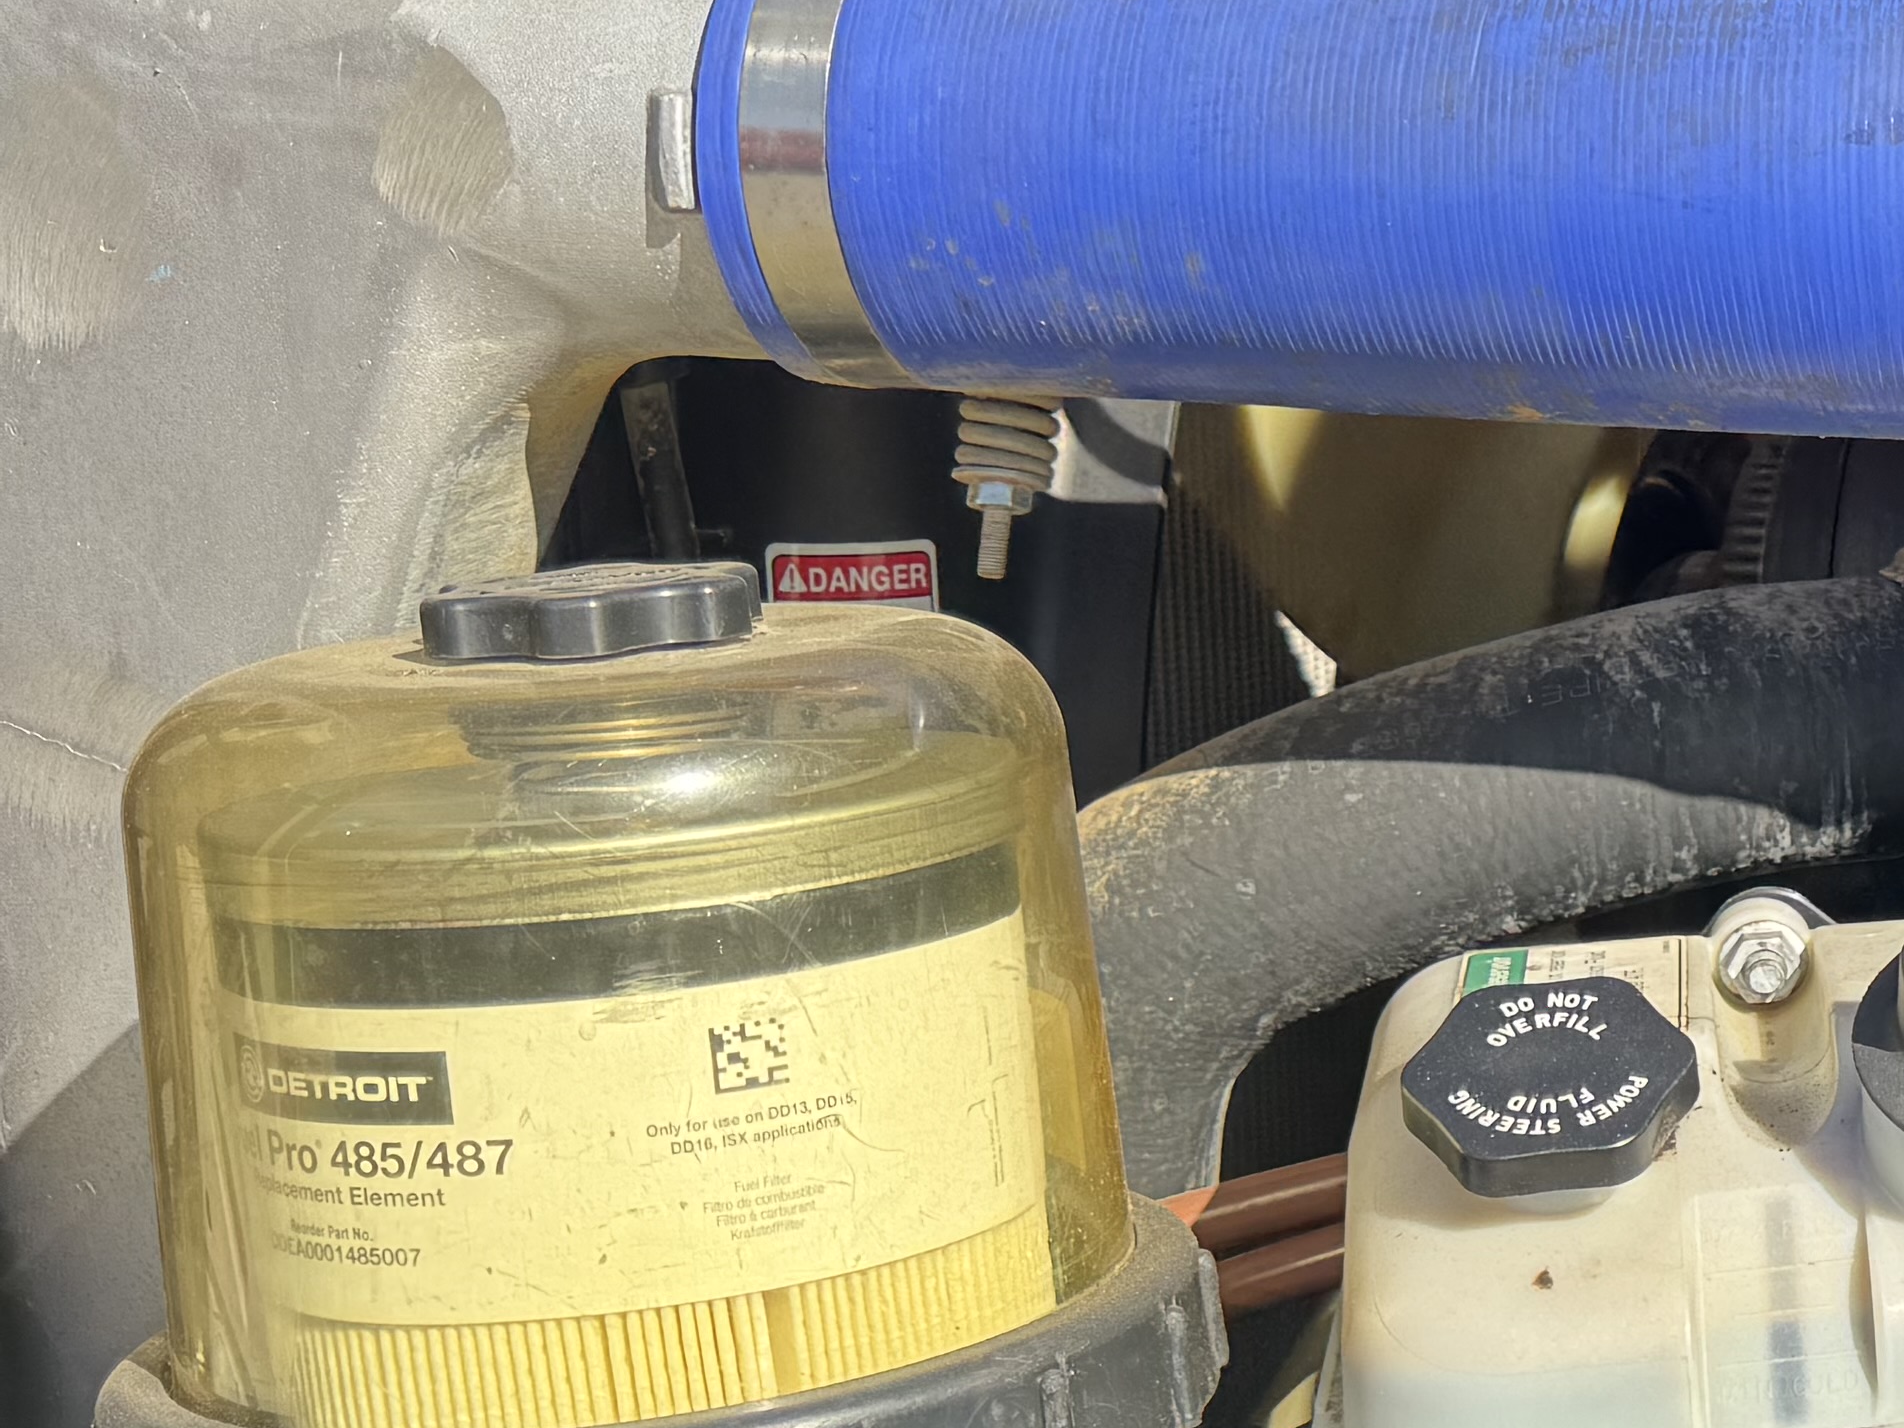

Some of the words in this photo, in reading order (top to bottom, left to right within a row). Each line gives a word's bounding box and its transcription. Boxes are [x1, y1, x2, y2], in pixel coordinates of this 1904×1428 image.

[808, 563, 927, 593] DANGER
[1499, 997, 1535, 1018] DO
[1547, 991, 1599, 1012] NOT
[1486, 1012, 1609, 1048] OVERFILL
[267, 1068, 428, 1102] DETROIT
[646, 1121, 681, 1138] Only
[686, 1119, 709, 1133] for
[745, 1112, 764, 1124] on
[768, 1100, 812, 1120] DD13,
[815, 1092, 858, 1112] DD15,
[1447, 1089, 1562, 1136] STEERING
[1506, 1086, 1596, 1115] FLUID
[1577, 1074, 1649, 1127] POWER
[722, 1131, 749, 1148] ISX
[753, 1116, 841, 1144] applications
[330, 1138, 514, 1180] 485/487
[350, 1186, 446, 1207] Element
[734, 1180, 760, 1193] Fuel
[763, 1173, 792, 1188] Filter
[703, 1200, 734, 1214] Filtro
[760, 1200, 816, 1221] carburant
[328, 1225, 350, 1239] Part
[352, 1227, 375, 1242] No.
